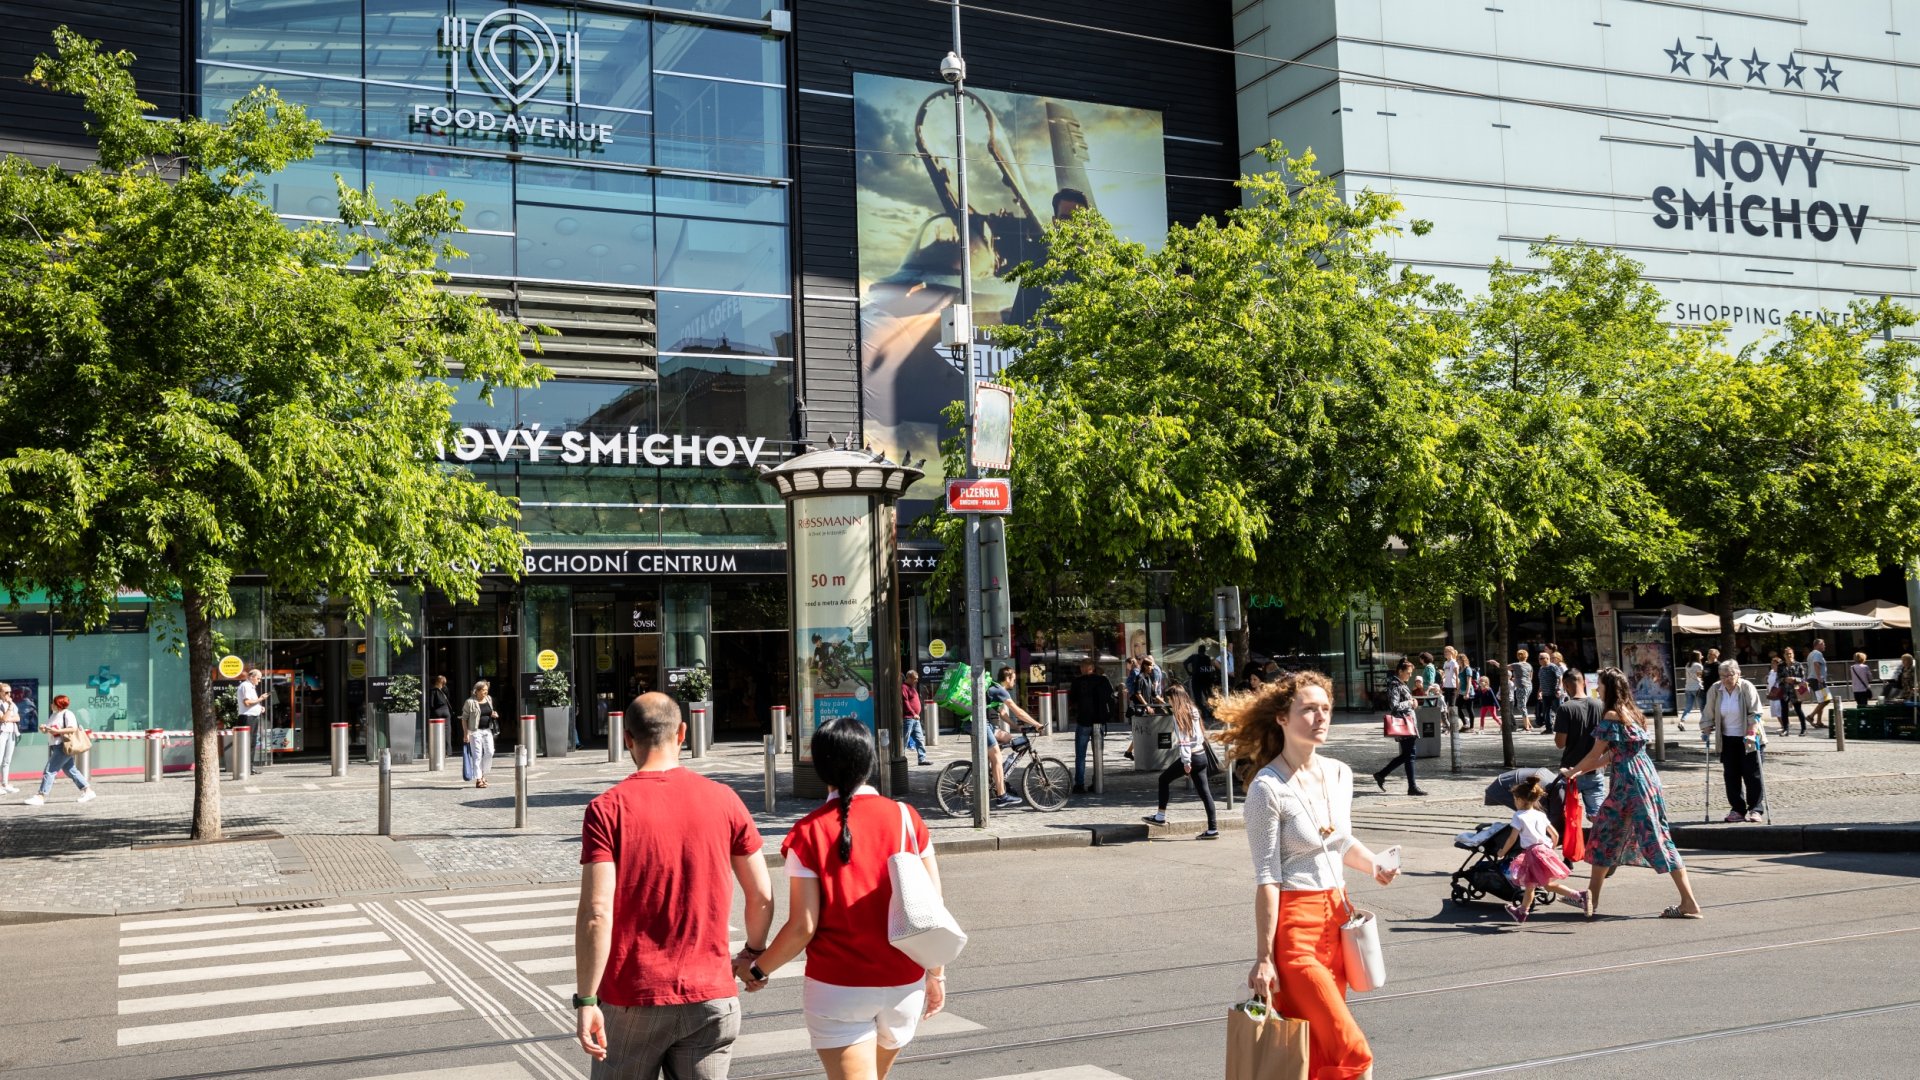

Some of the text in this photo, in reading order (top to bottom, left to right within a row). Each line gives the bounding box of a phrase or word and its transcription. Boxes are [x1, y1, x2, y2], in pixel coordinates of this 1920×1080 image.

[414, 104, 614, 144] FOOD AVENUE
[1693, 135, 1825, 188] NOVÝ
[1652, 182, 1870, 245] SMÍCHOV
[1676, 302, 1852, 327] SHOPPING ENTE
[560, 425, 766, 468] SMÍCHOV
[960, 486, 1000, 498] PLZEŇSKÁ
[798, 515, 862, 529] ROSSMANN
[525, 551, 737, 573] BCHODNÍ CENTRUM
[811, 573, 846, 588] 50 m
[88, 695, 120, 704] DERMO
